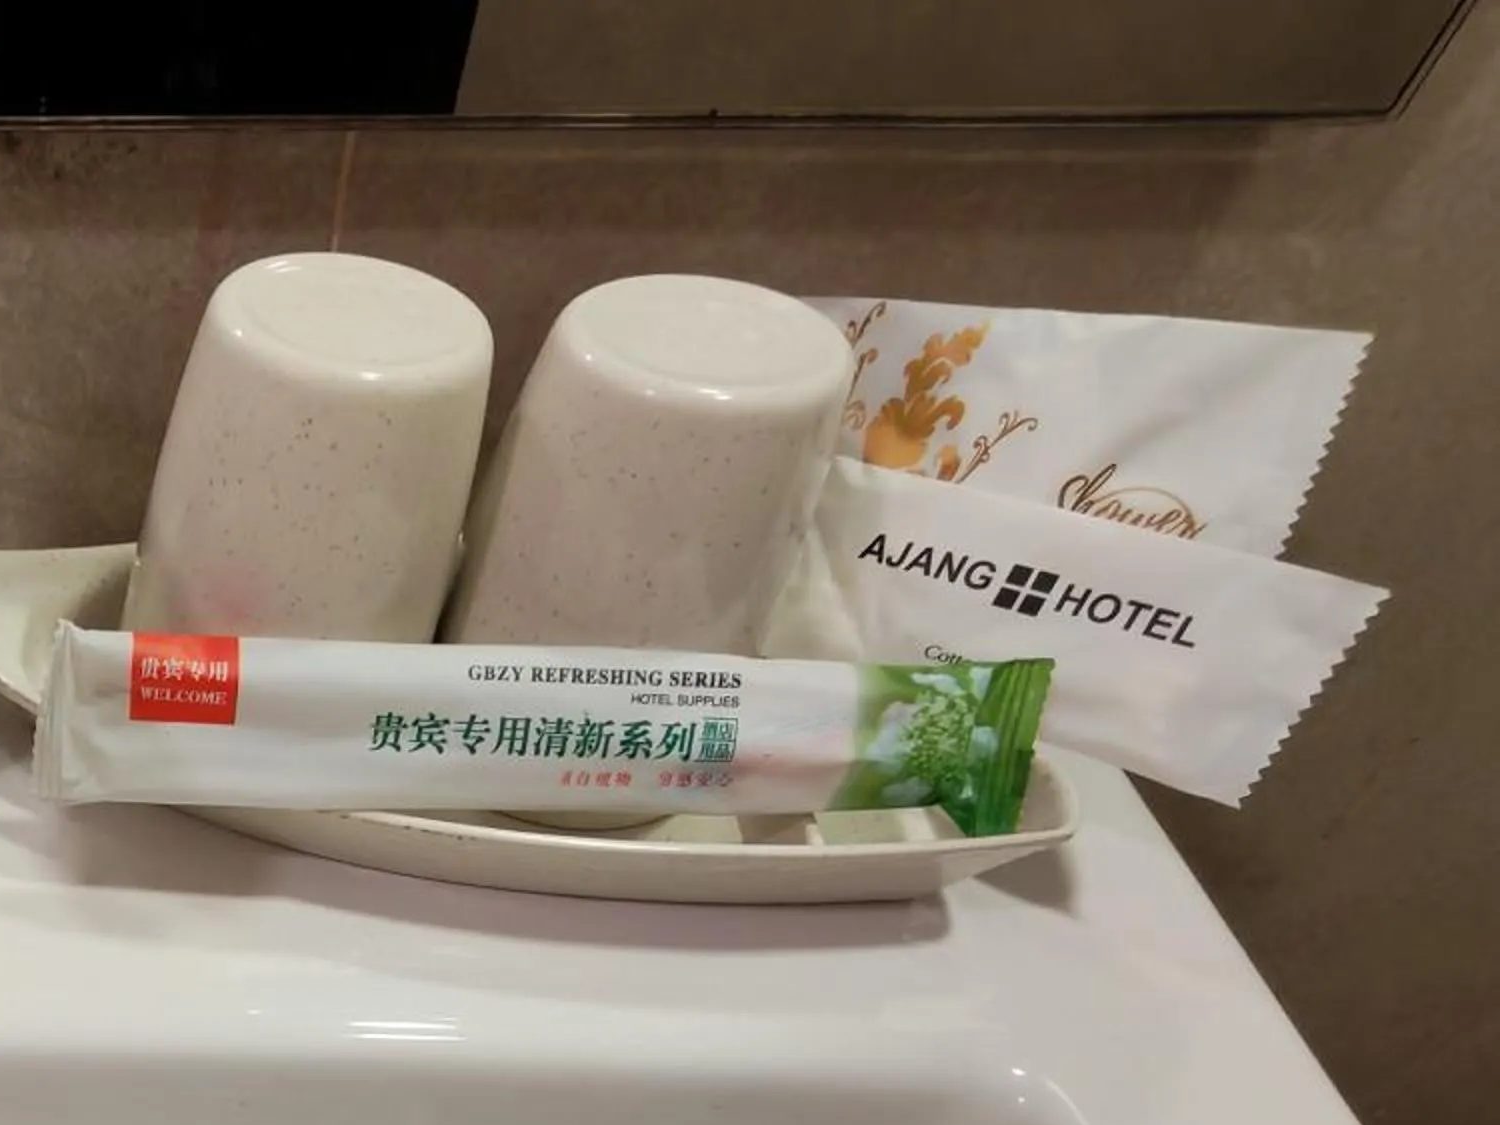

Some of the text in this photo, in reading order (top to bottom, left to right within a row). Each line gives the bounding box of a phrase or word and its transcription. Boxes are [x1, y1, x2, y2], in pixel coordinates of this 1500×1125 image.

[857, 533, 1197, 649] AJANG HOTEL
[141, 656, 228, 682] 贵宾专用
[467, 665, 742, 689] GBZY REFRESHING SERIES
[141, 686, 228, 706] WELCOME
[630, 693, 741, 708] HOTEL SUPPLIES
[368, 710, 698, 762] 贵宾专用清新系列
